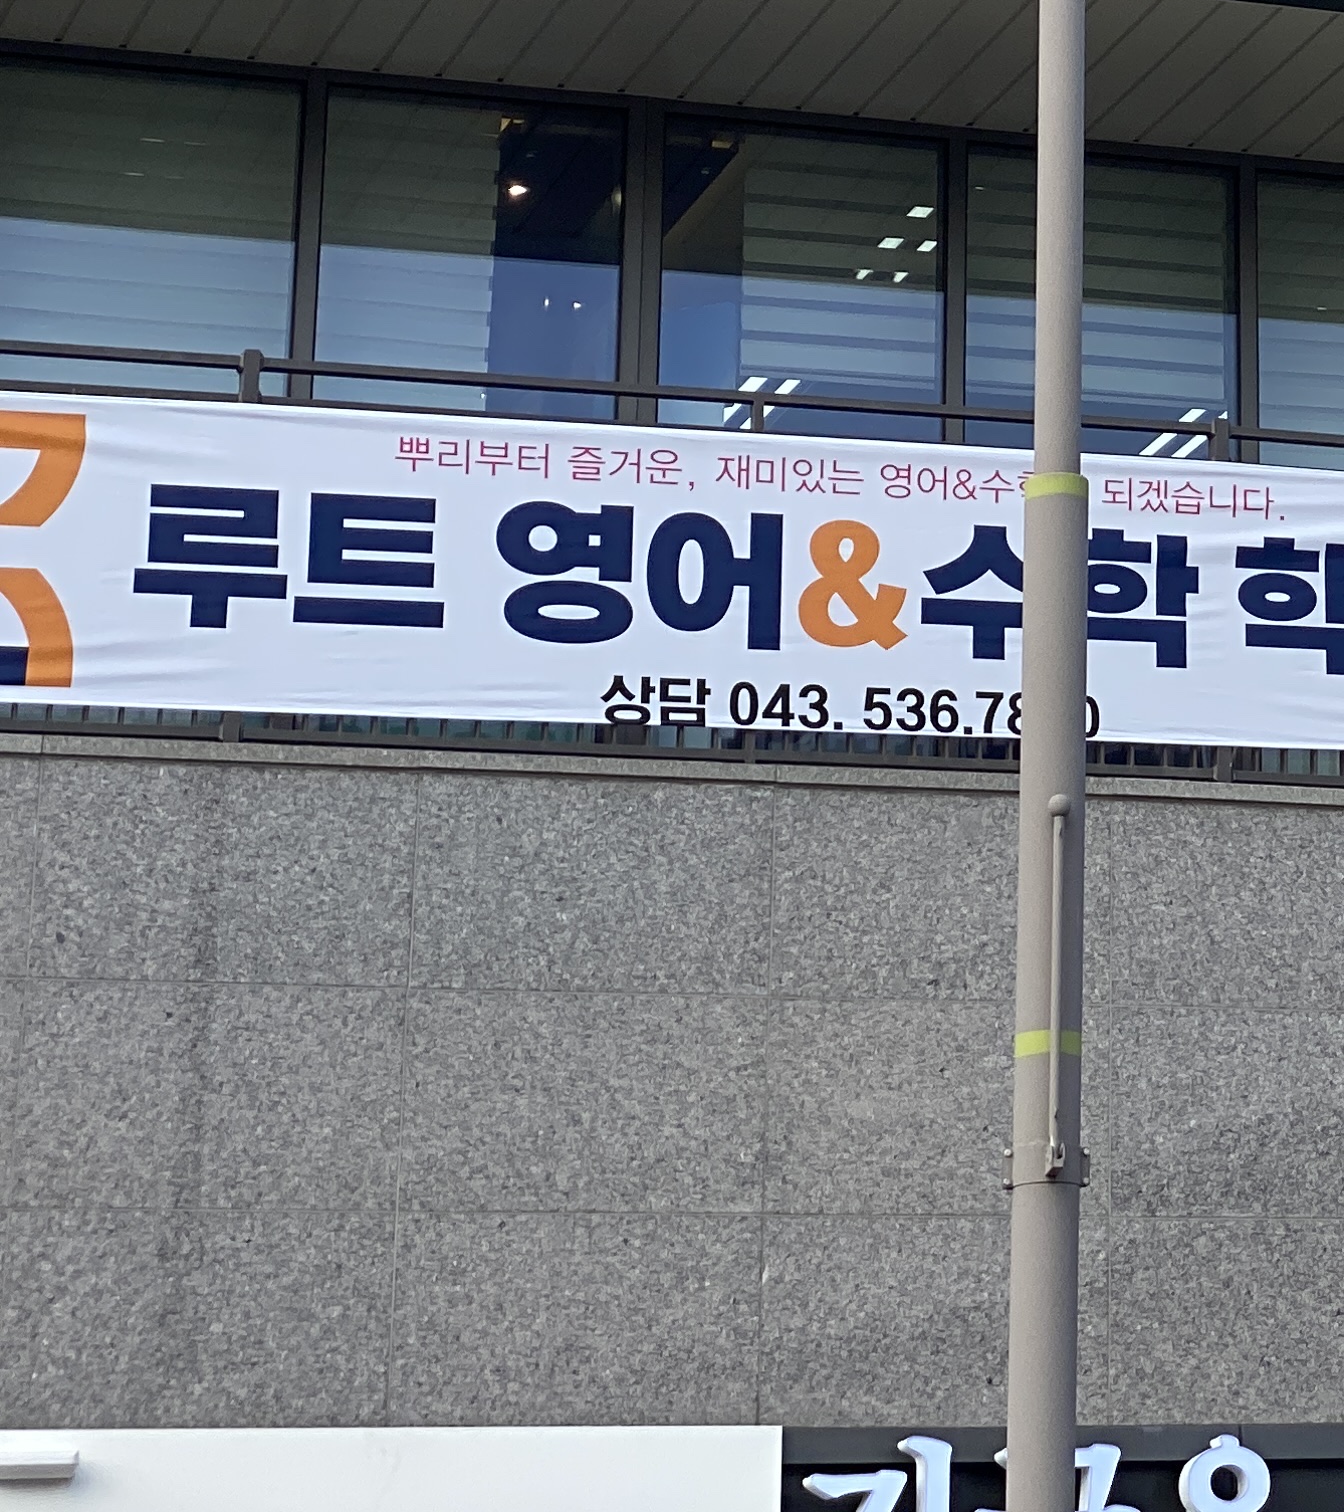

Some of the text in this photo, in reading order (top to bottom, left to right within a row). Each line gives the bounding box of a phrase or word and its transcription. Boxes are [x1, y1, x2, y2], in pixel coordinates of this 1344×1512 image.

[395, 436, 1286, 521] 뿌리부터 즐거운, 재미있는 영어&수 되겠습니다.
[133, 483, 445, 628] 루트
[600, 675, 711, 727] 상담
[729, 681, 843, 730] 043.
